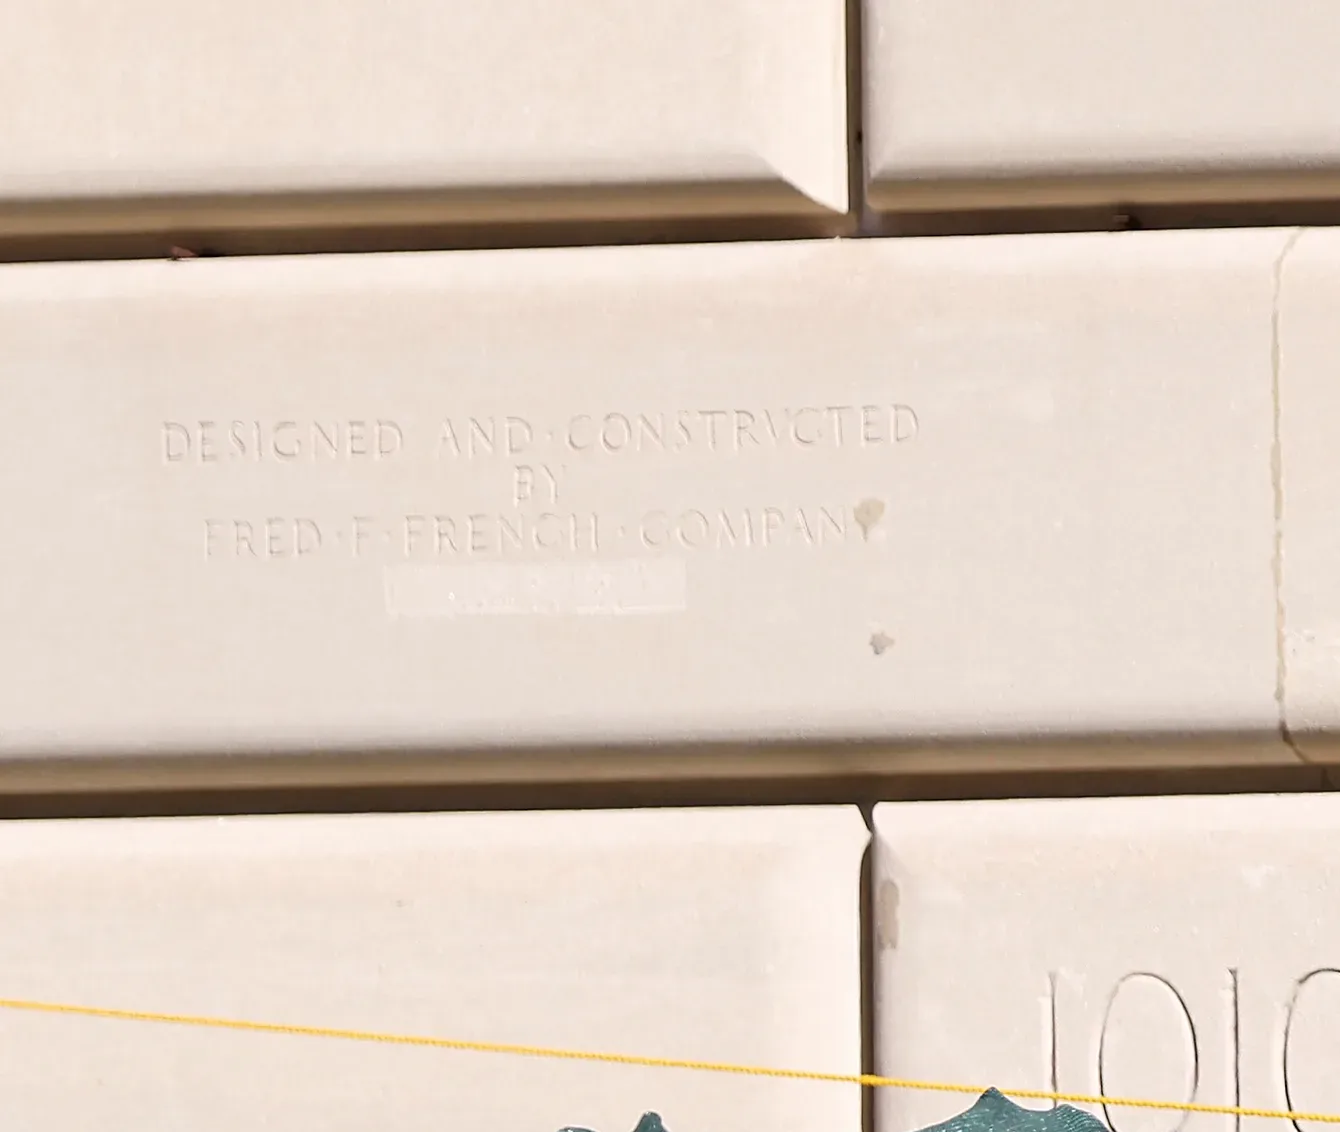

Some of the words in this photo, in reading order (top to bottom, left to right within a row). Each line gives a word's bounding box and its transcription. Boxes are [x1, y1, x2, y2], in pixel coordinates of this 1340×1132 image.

[161, 417, 403, 463] DESIGNED
[437, 413, 534, 460] AND
[512, 463, 567, 507] BY
[203, 515, 323, 561] FRED
[352, 513, 375, 558] F
[403, 508, 600, 557] FRENCH
